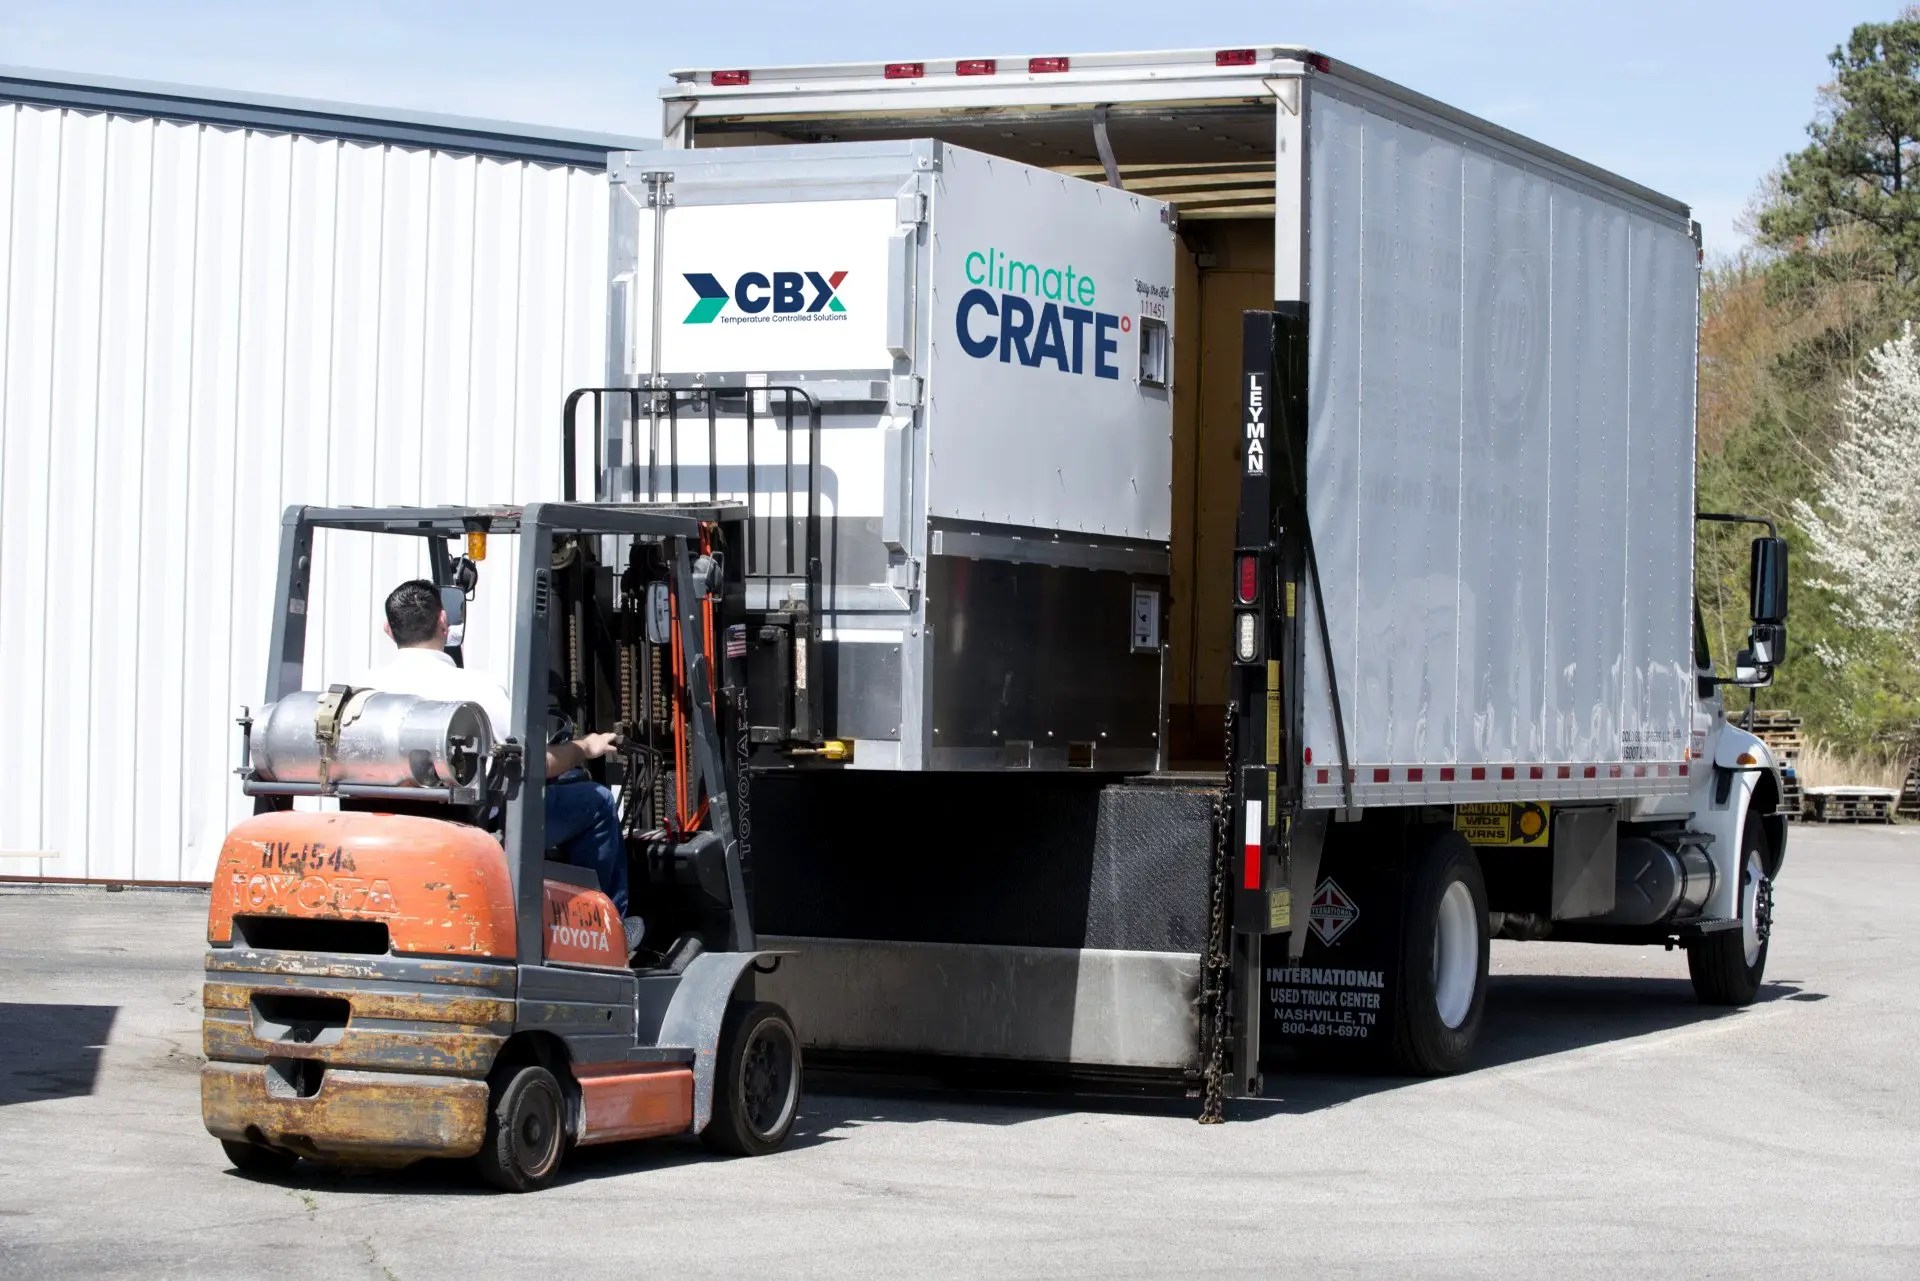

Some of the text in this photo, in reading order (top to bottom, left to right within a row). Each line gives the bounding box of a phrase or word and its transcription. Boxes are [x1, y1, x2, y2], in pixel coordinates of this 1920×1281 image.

[965, 248, 1096, 307] climate
[734, 271, 849, 314] CBX
[721, 312, 848, 325] Temperature Controlled Solutions
[1246, 375, 1265, 470] LEYMAN
[737, 734, 751, 860] TOYOTA
[1458, 802, 1509, 815] CAUTION
[1465, 816, 1501, 825] WIDE
[1310, 906, 1354, 917] TERNATIONAL
[550, 924, 609, 952] TOYOTA
[1266, 967, 1385, 988] INTERNATIONAL
[1270, 988, 1381, 1009] USED TRUCK CENTER
[1274, 1008, 1376, 1025] NASHVILLE, TN
[1282, 1022, 1368, 1038] 800-481-6970
